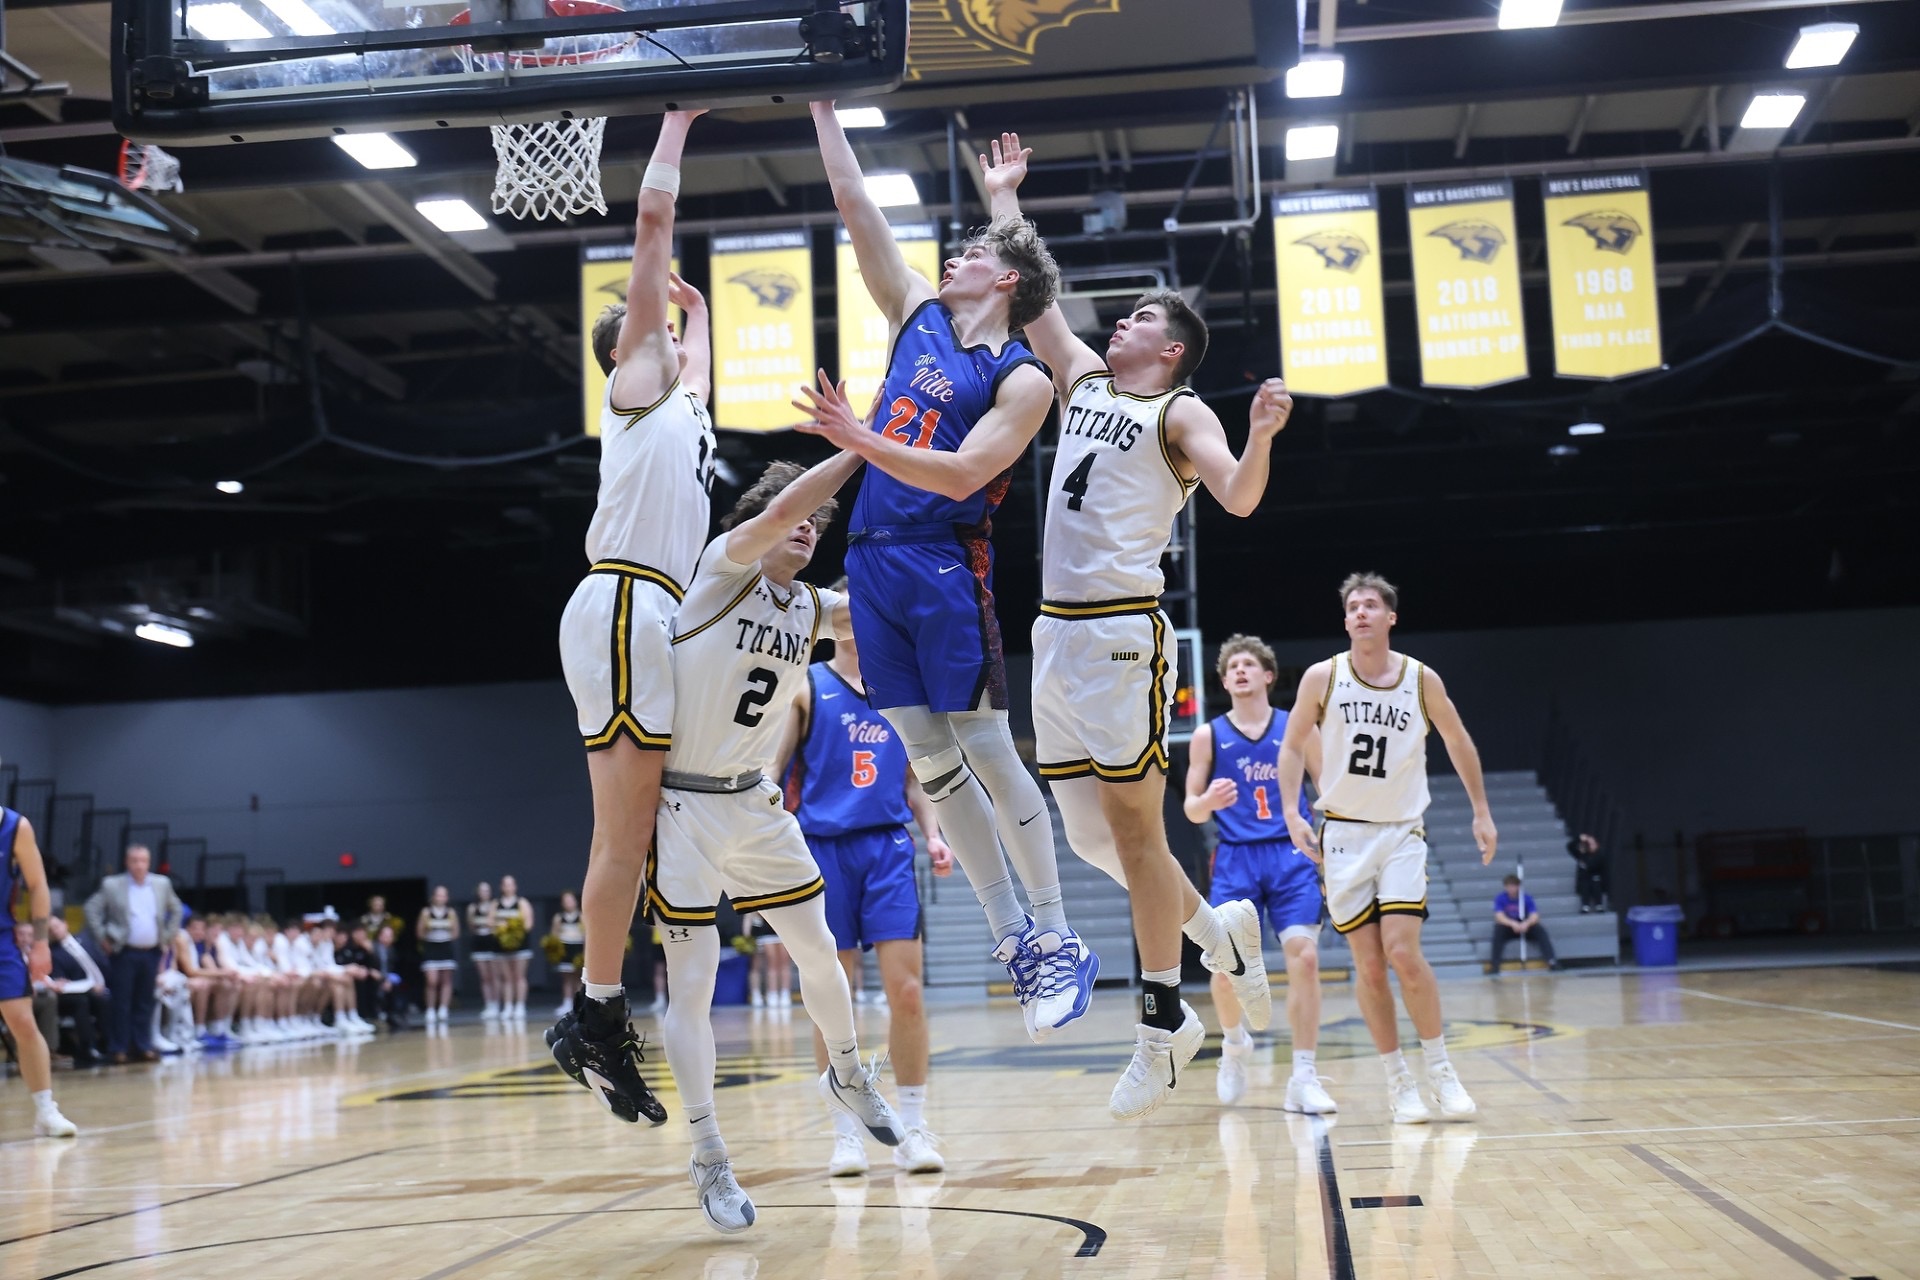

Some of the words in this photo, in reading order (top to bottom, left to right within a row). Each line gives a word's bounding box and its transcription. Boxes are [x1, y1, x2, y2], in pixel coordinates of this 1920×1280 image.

[1446, 184, 1505, 200] BASKETBALL
[1582, 175, 1641, 191] BASKETBALL
[1437, 276, 1498, 306] 2018
[1574, 267, 1634, 296] 1968
[1428, 310, 1511, 333] NATIONAL
[1584, 301, 1626, 321] NAIA
[1291, 319, 1373, 341] NATIONAL
[1608, 328, 1653, 346] PLACE
[915, 353, 937, 366] The
[1290, 345, 1377, 368] CHAMPION
[910, 367, 954, 402] Ville
[882, 396, 941, 450] 21
[1065, 406, 1143, 452] TITANS
[1062, 452, 1097, 511] 4
[736, 618, 810, 666] TITANS
[1111, 652, 1139, 661] UWO
[733, 667, 779, 728] 2
[1339, 702, 1411, 731] TITANS
[848, 720, 890, 744] Ville
[852, 751, 878, 788] 5
[1348, 733, 1388, 779] 21
[1254, 786, 1272, 820] 1
